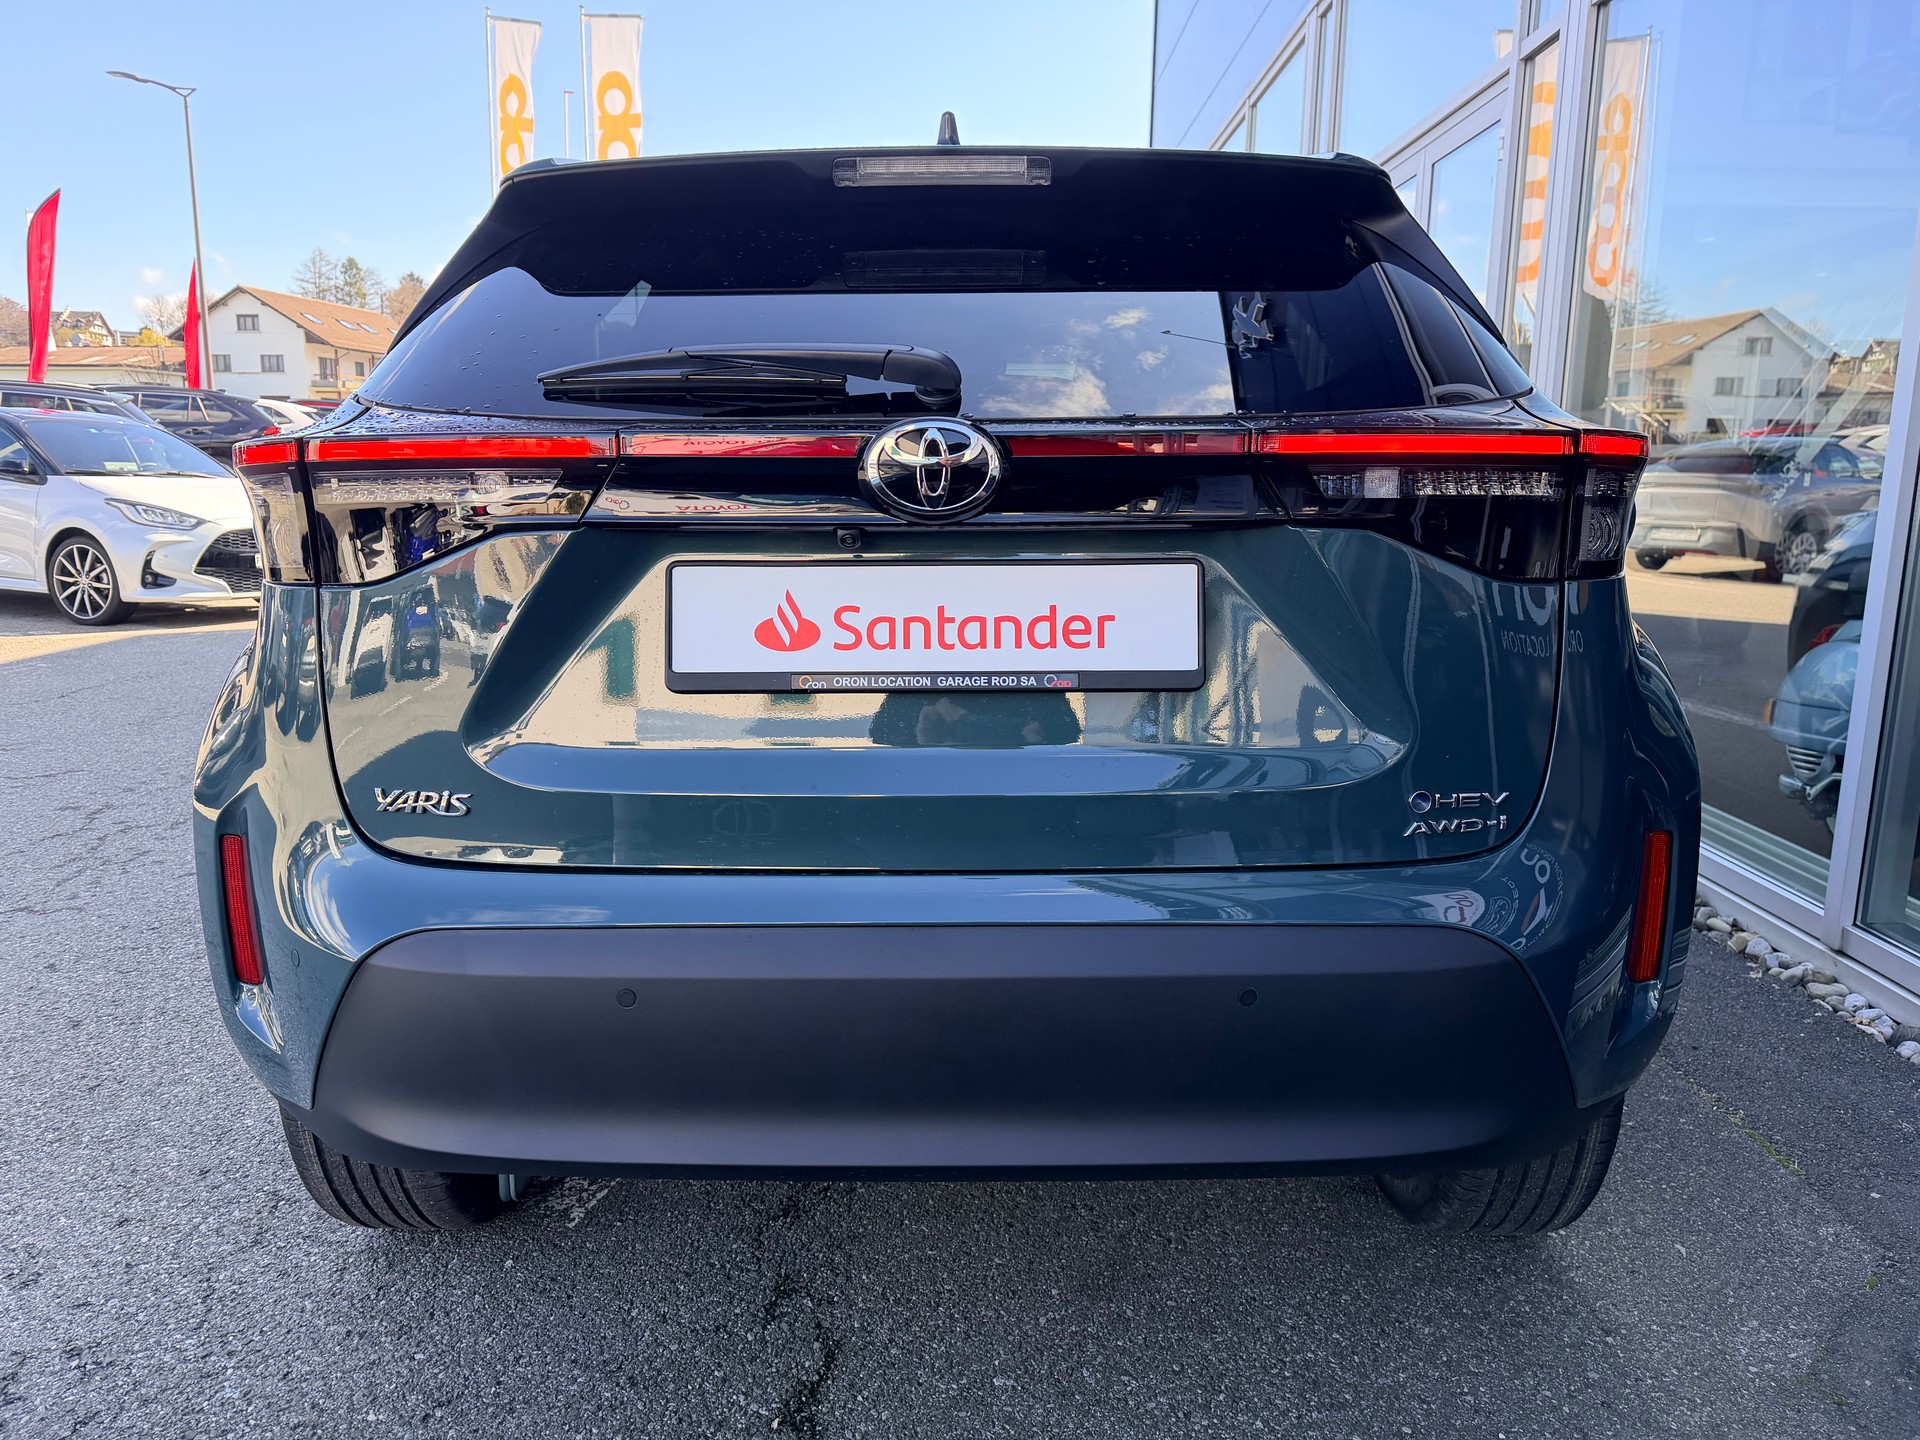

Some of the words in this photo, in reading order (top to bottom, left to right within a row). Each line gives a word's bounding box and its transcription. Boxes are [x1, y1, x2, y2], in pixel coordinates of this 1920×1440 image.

[833, 604, 1116, 651] Santander
[833, 676, 868, 688] ORON
[871, 676, 931, 688] LOCATION
[937, 675, 989, 687] GARAGE
[991, 675, 1018, 687] ROD
[1020, 675, 1037, 687] SA
[1434, 791, 1510, 809] HEV
